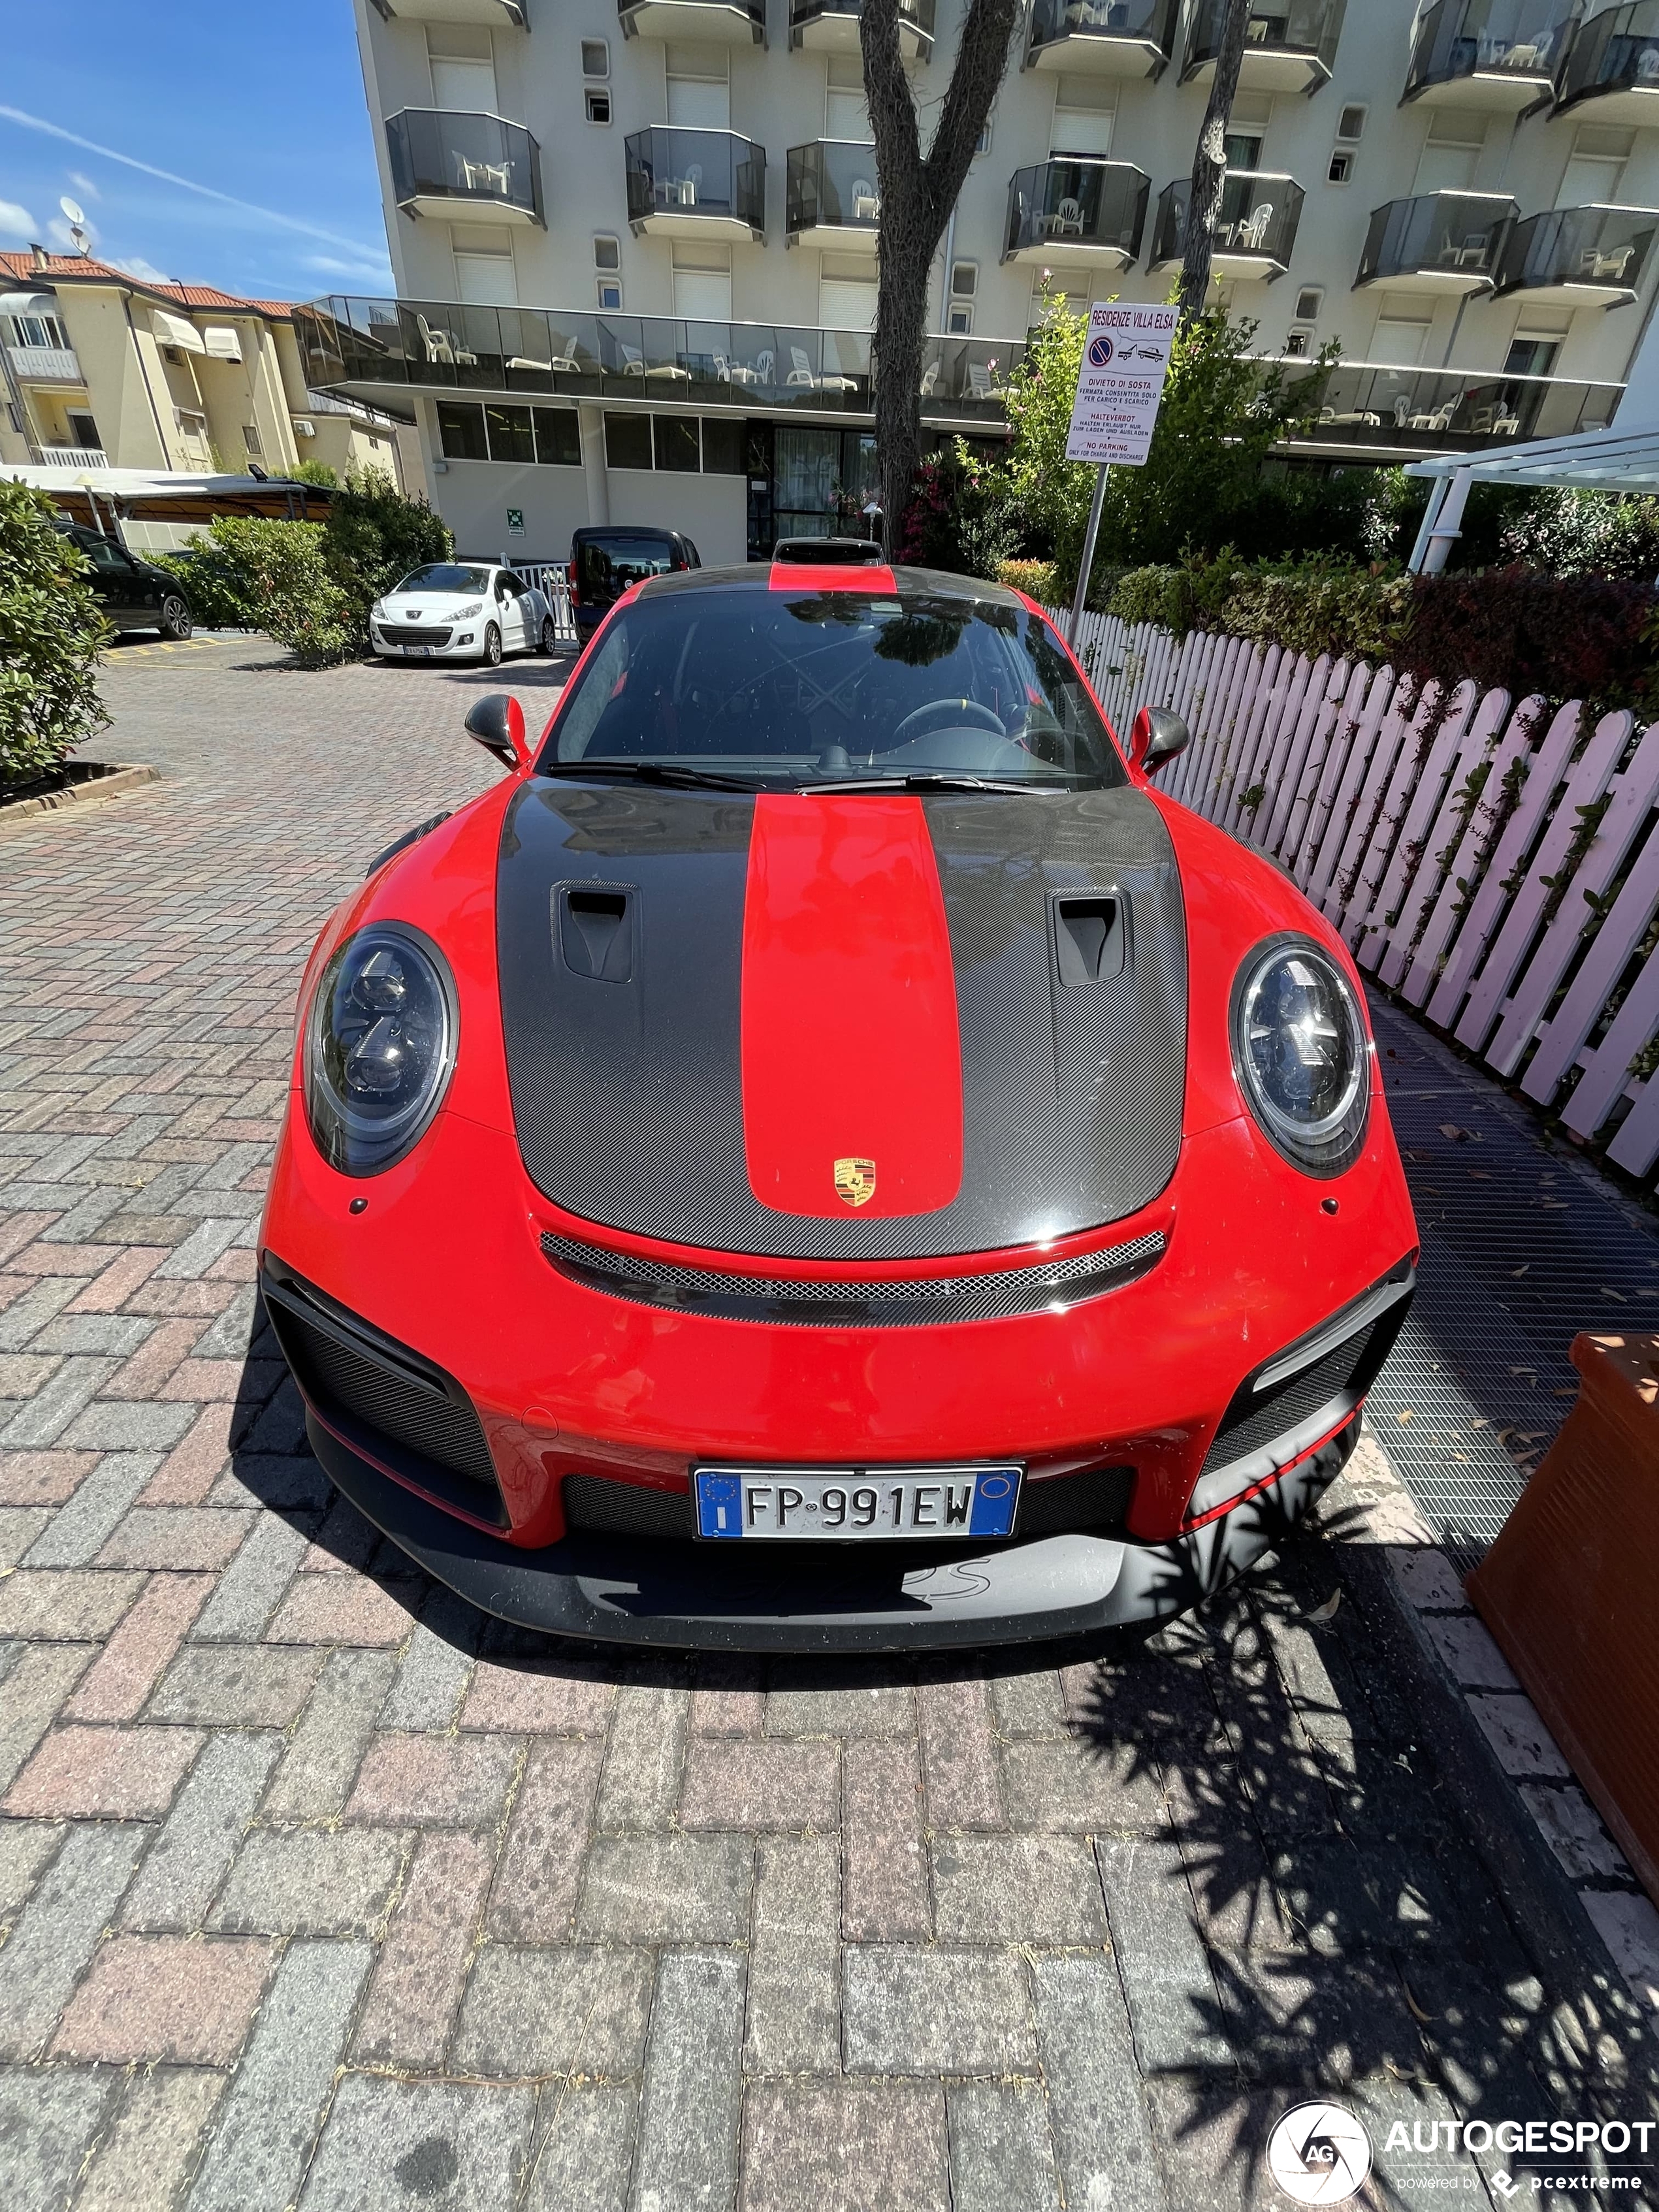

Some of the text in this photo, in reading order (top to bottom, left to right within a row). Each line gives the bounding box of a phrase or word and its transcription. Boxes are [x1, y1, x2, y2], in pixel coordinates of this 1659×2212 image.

[1091, 310, 1174, 329] RESIDENZE VILLA ELSA
[1088, 378, 1116, 387] DIVIETO
[1128, 381, 1152, 389] SOSTA
[1091, 413, 1136, 423] HALTEVERBOT
